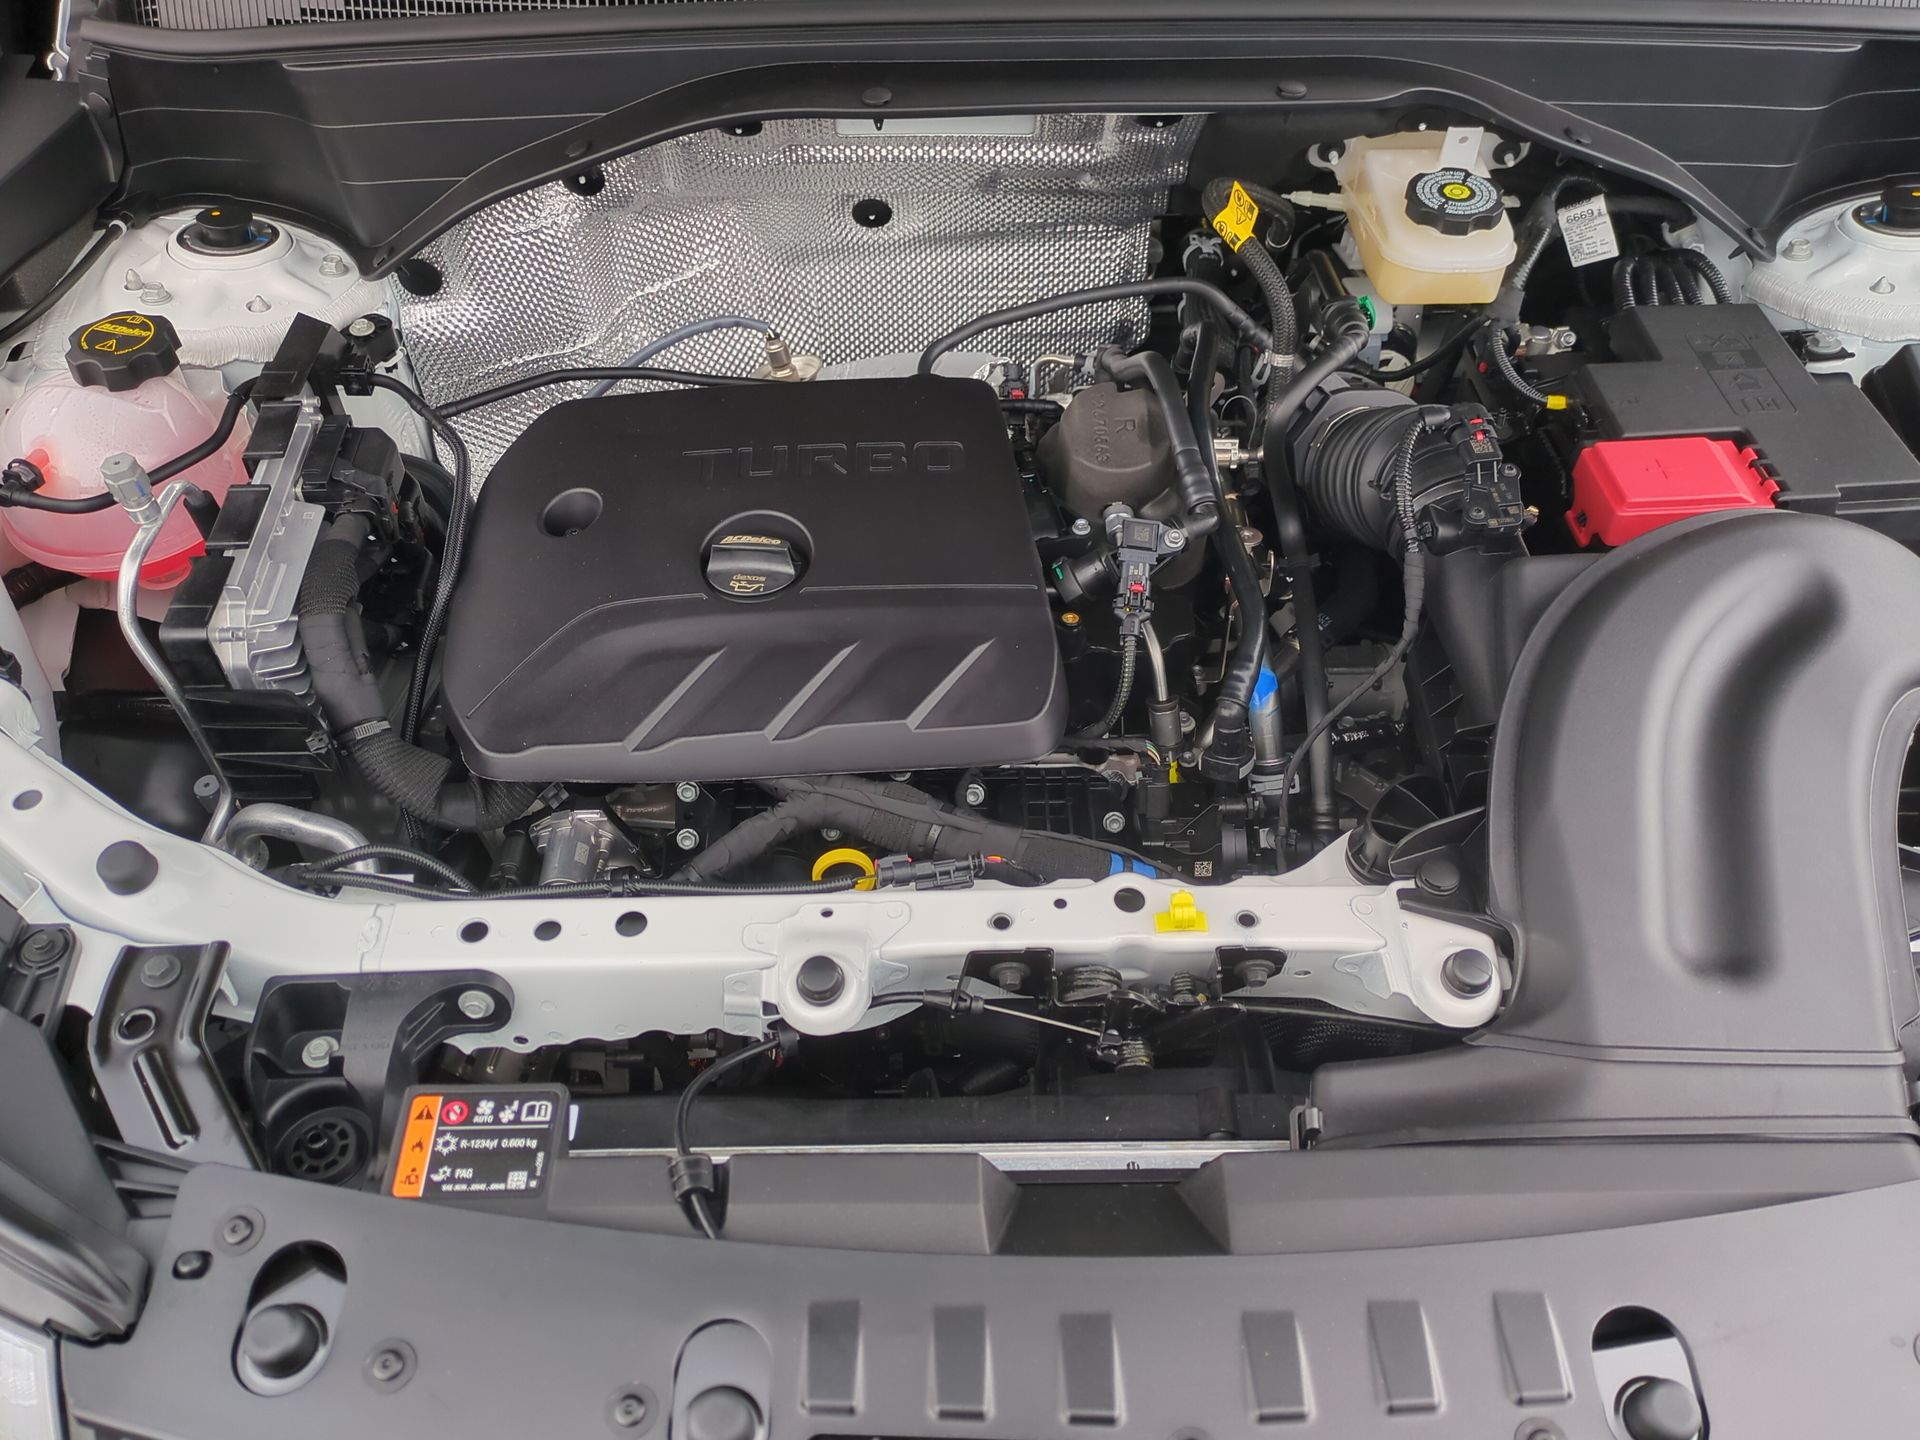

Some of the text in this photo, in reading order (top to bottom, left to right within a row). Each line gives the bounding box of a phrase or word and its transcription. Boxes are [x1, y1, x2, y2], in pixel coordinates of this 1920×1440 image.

[1566, 208, 1594, 224] 6669
[1114, 416, 1136, 434] R
[682, 441, 965, 480] TURBO
[720, 535, 782, 545] ACDelco
[733, 573, 767, 582] dexos
[473, 1115, 494, 1124] AUTO
[460, 1138, 499, 1150] R-1234yf
[526, 1137, 538, 1149] kg
[454, 1168, 474, 1179] PAG
